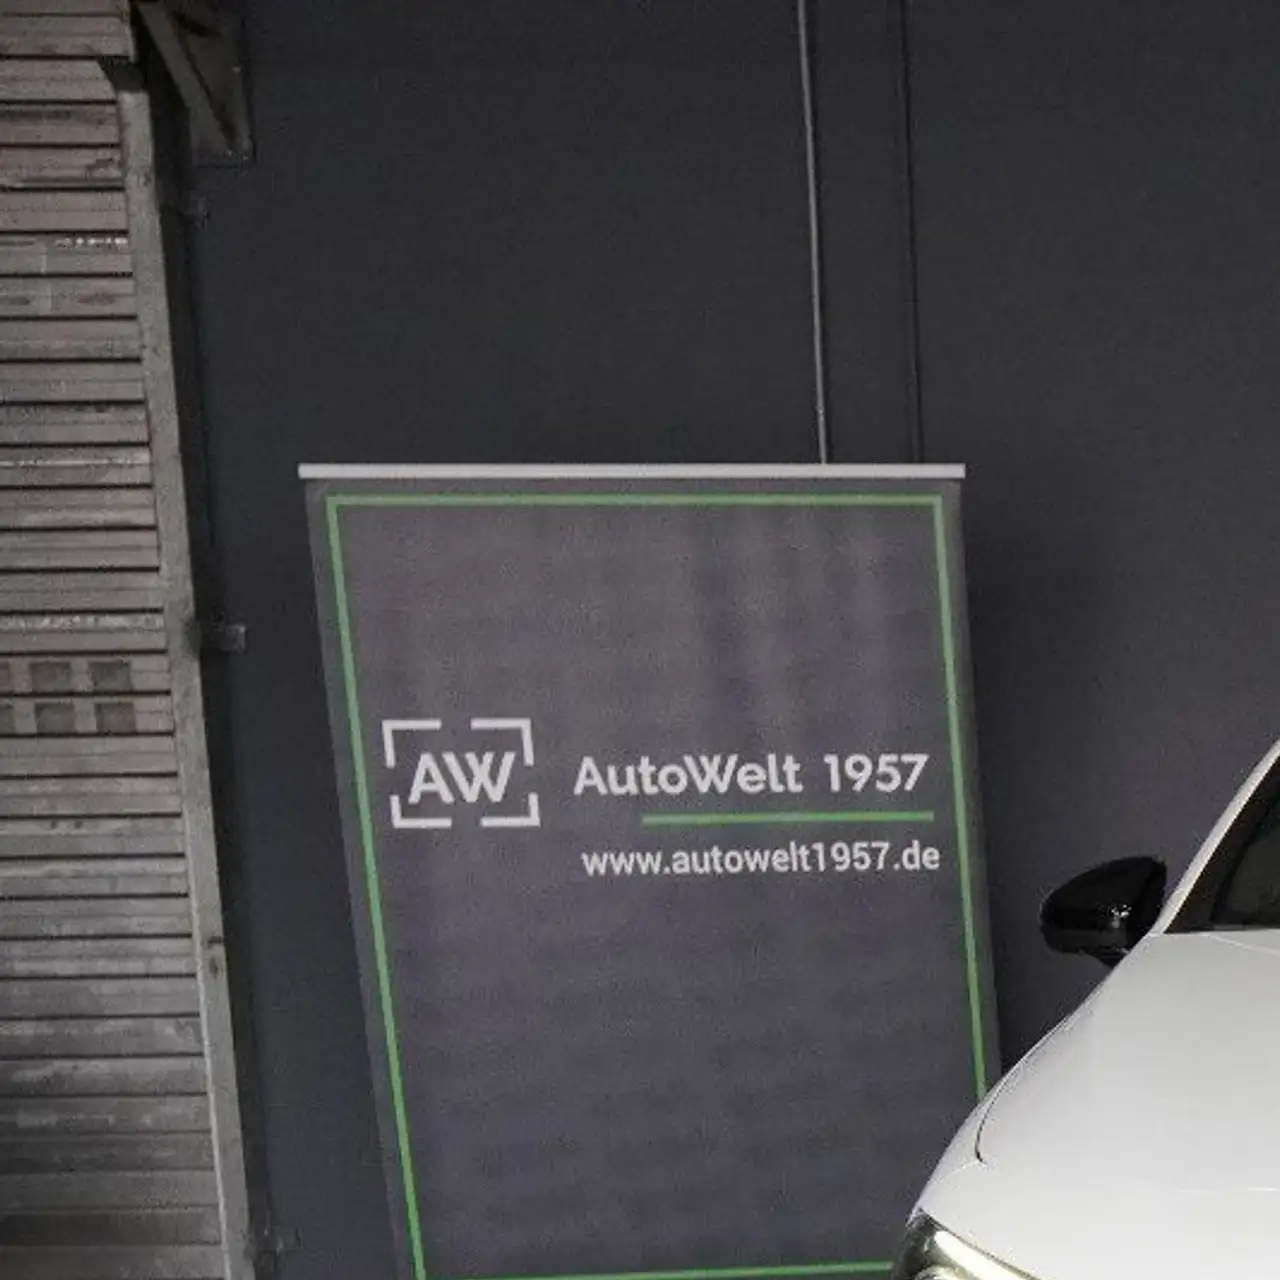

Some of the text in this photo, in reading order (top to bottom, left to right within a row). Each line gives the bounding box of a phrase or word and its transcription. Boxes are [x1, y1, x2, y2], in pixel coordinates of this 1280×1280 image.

[408, 752, 516, 804] AW
[573, 754, 929, 796] AutoWelt 1957
[581, 841, 941, 877] www.autowelt1957.de
